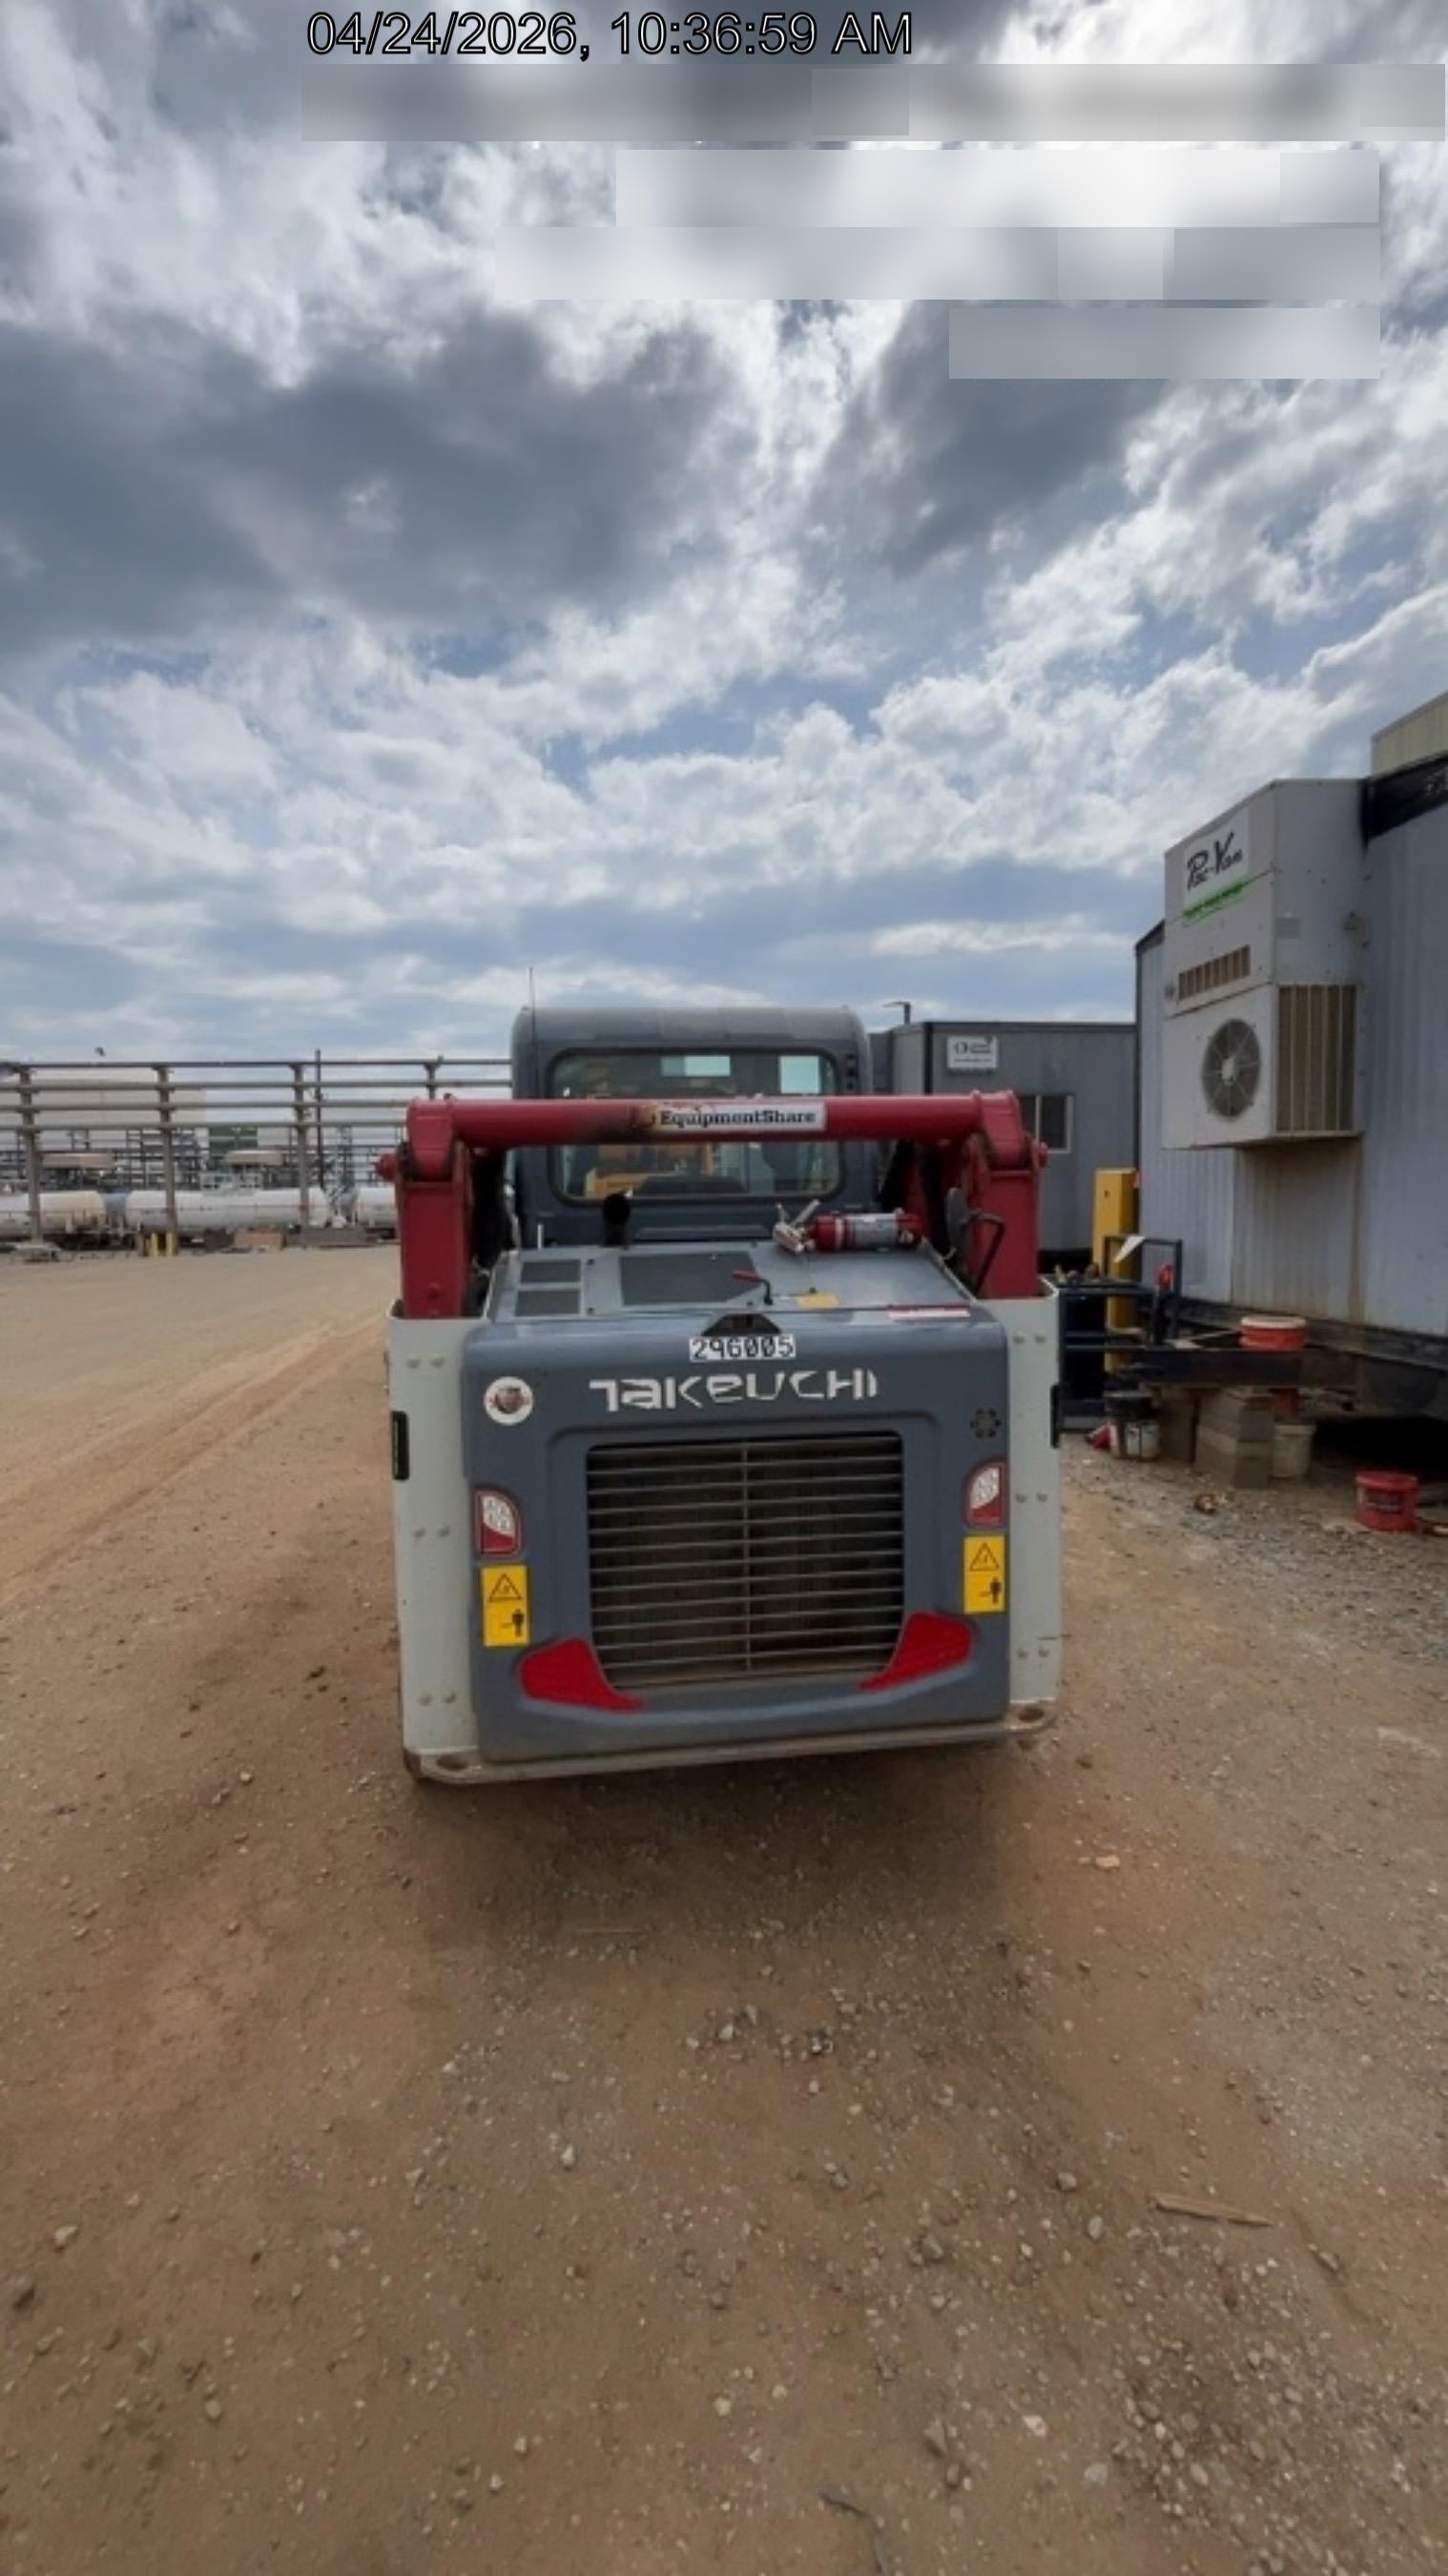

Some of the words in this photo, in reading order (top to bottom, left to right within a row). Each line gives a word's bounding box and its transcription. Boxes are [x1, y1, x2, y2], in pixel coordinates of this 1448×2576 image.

[659, 1107, 817, 1129] EquipmentShare
[693, 1336, 794, 1360] 296005
[589, 1368, 879, 1413] TAKEUCHI
